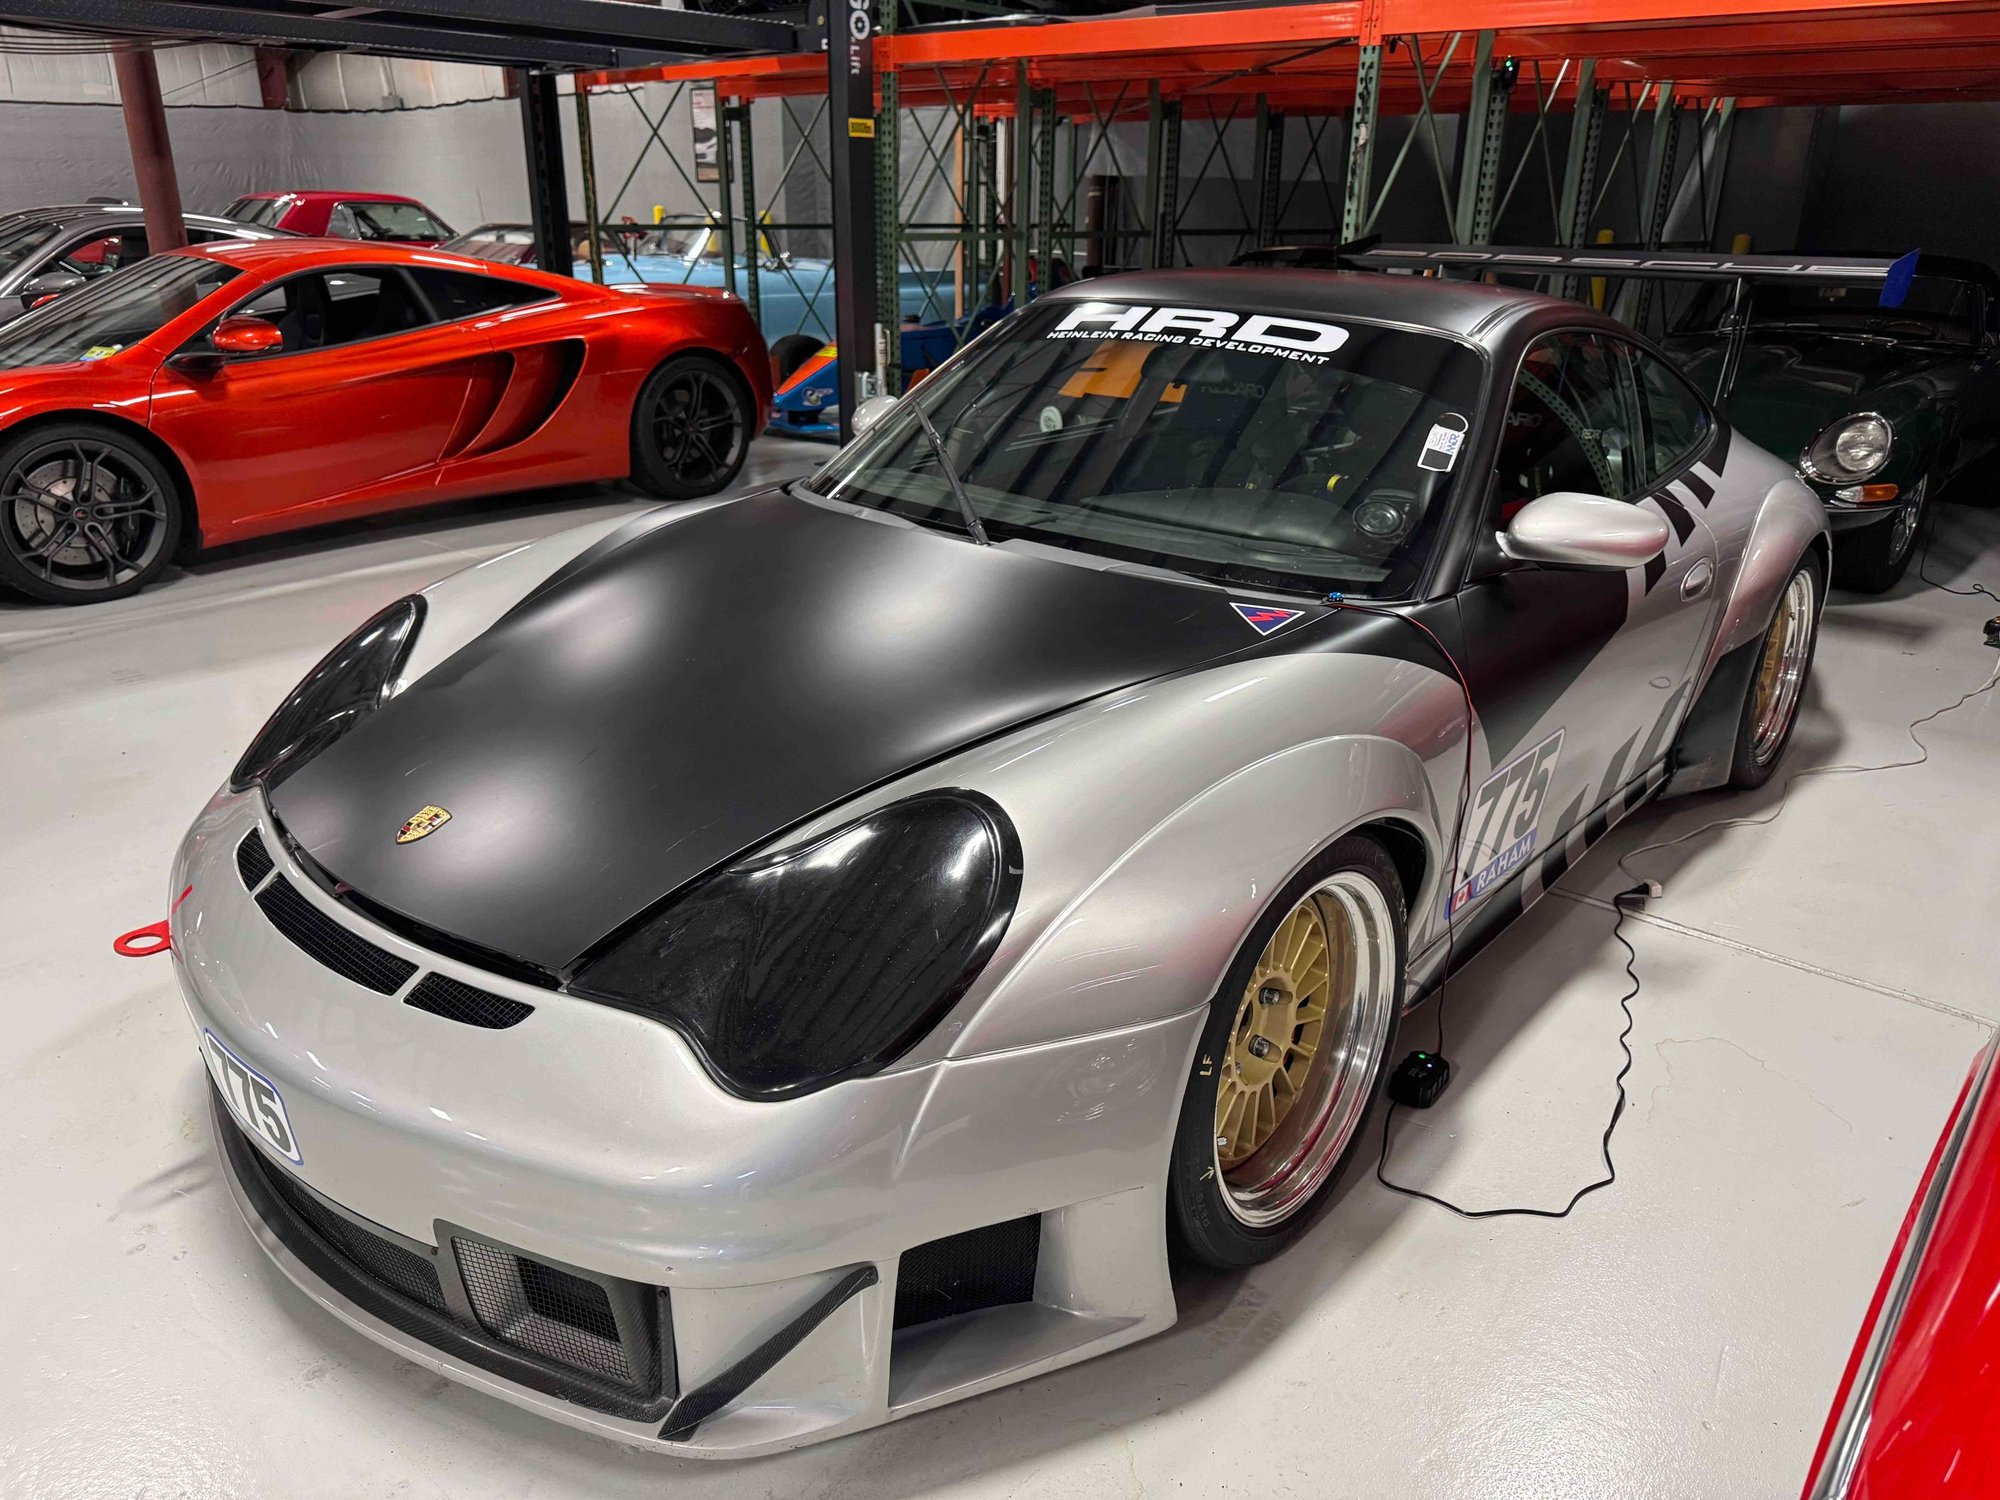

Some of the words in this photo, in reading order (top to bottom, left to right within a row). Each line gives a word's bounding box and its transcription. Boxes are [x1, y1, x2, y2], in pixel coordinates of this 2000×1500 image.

[1364, 250, 1889, 276] PORSCHE
[1047, 330, 1118, 340] HEINLEIN
[1121, 331, 1186, 345] RACING
[1189, 337, 1330, 366] DEVELOPMENT
[1055, 302, 1350, 353] HRD
[1462, 732, 1562, 880] 775
[1476, 835, 1531, 892] RAHAM
[1200, 1054, 1212, 1076] LF
[207, 1034, 291, 1153] 775
